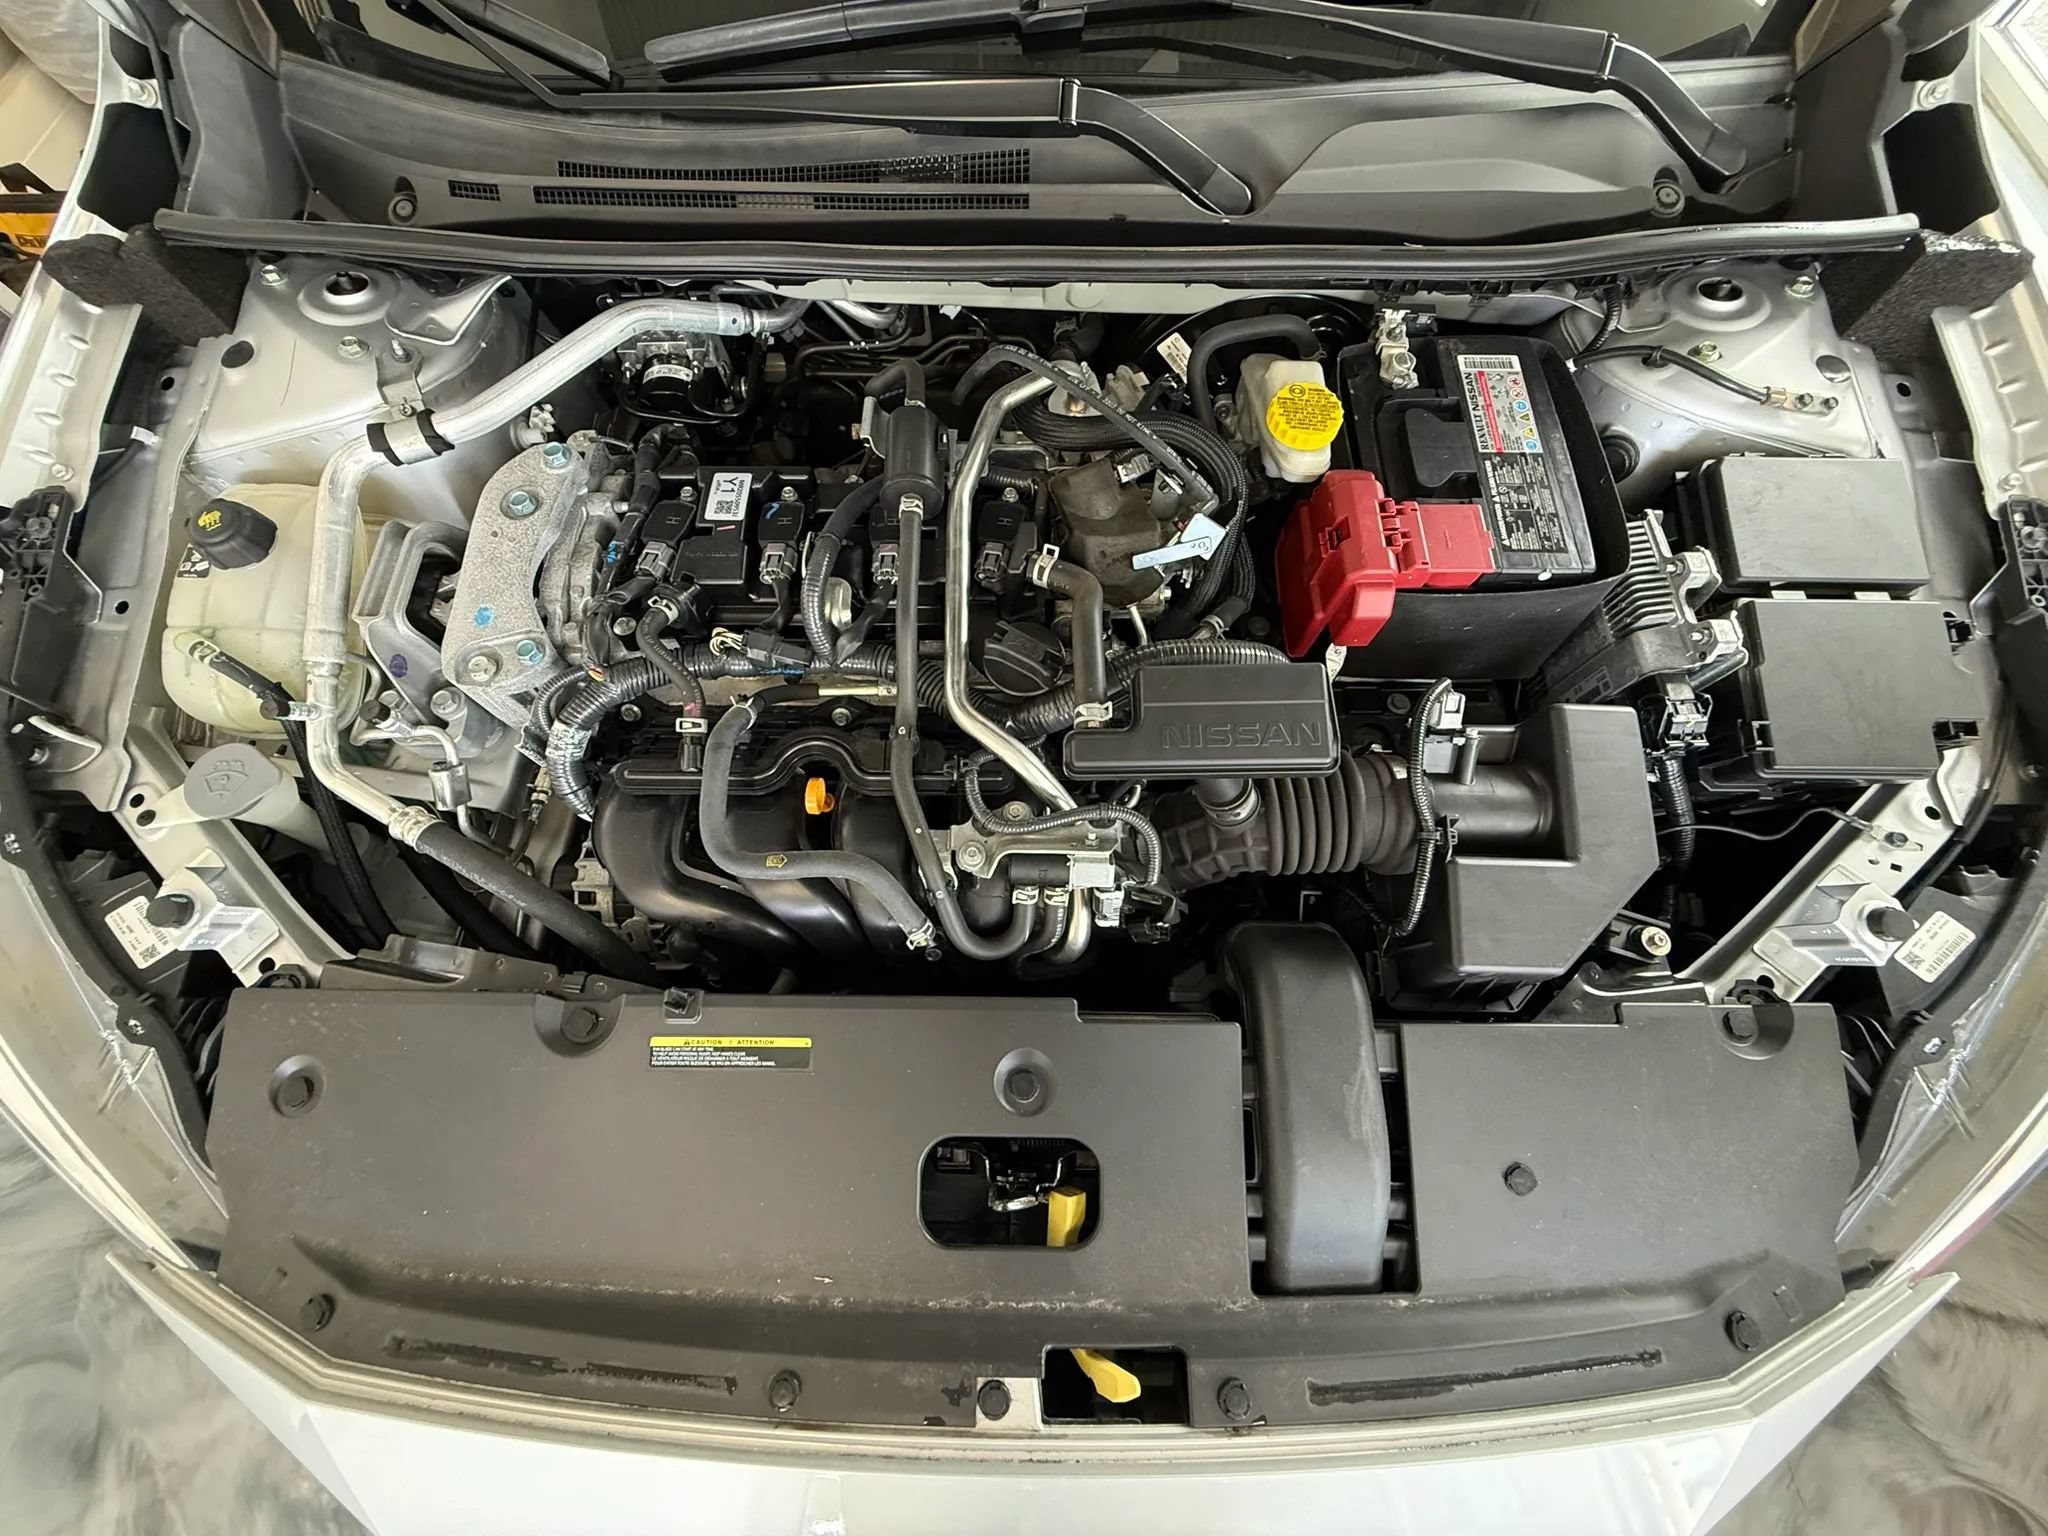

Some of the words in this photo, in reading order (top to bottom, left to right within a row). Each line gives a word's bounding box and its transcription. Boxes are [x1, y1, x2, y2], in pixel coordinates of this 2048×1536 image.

[1463, 372, 1480, 412] NISSAN
[1473, 413, 1489, 450] RENAULT
[1162, 720, 1323, 749] NISSAN
